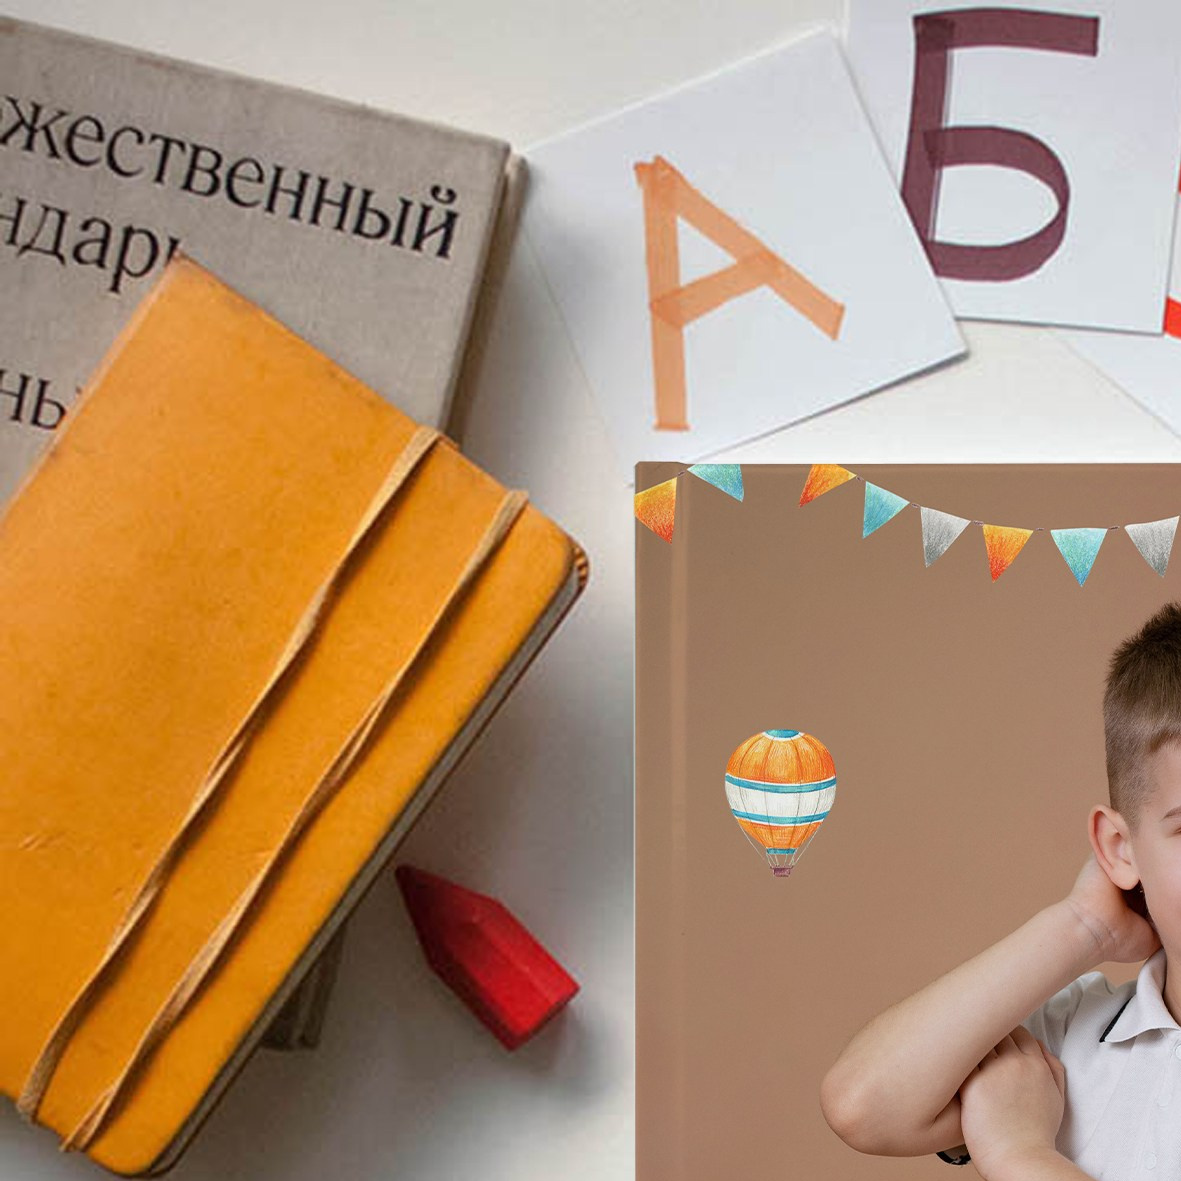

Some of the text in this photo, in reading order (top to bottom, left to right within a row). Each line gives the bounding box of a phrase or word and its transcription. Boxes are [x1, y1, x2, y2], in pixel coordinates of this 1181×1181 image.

[0, 95, 460, 261] жественный
[900, 8, 1100, 282] Б
[633, 154, 845, 431] А
